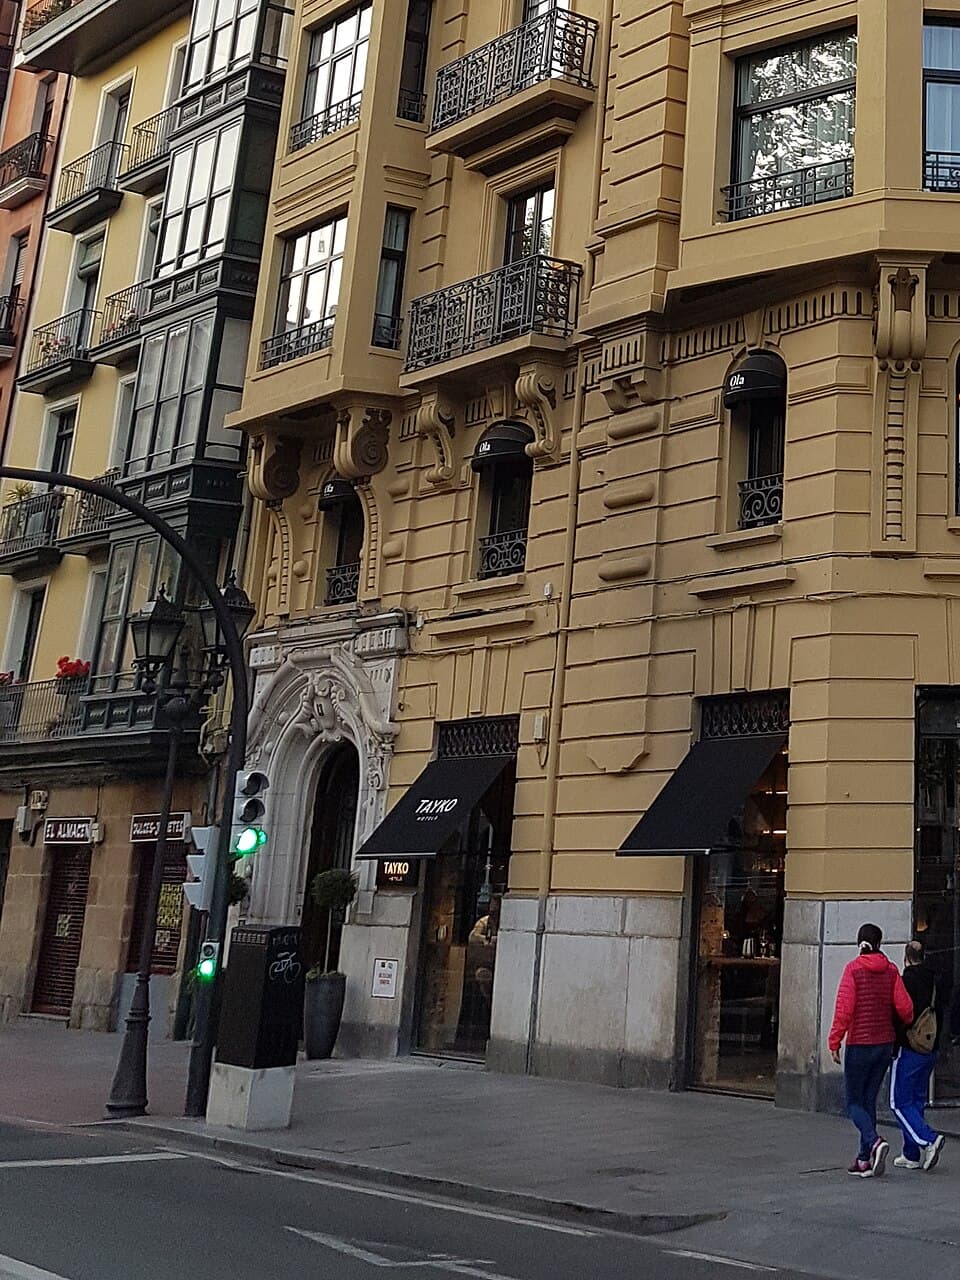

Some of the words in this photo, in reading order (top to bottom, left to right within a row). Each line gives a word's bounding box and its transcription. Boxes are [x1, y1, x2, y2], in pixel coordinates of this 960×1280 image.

[729, 373, 745, 387] Ola
[415, 798, 458, 814] TAYKO
[383, 861, 409, 875] TAYKO
